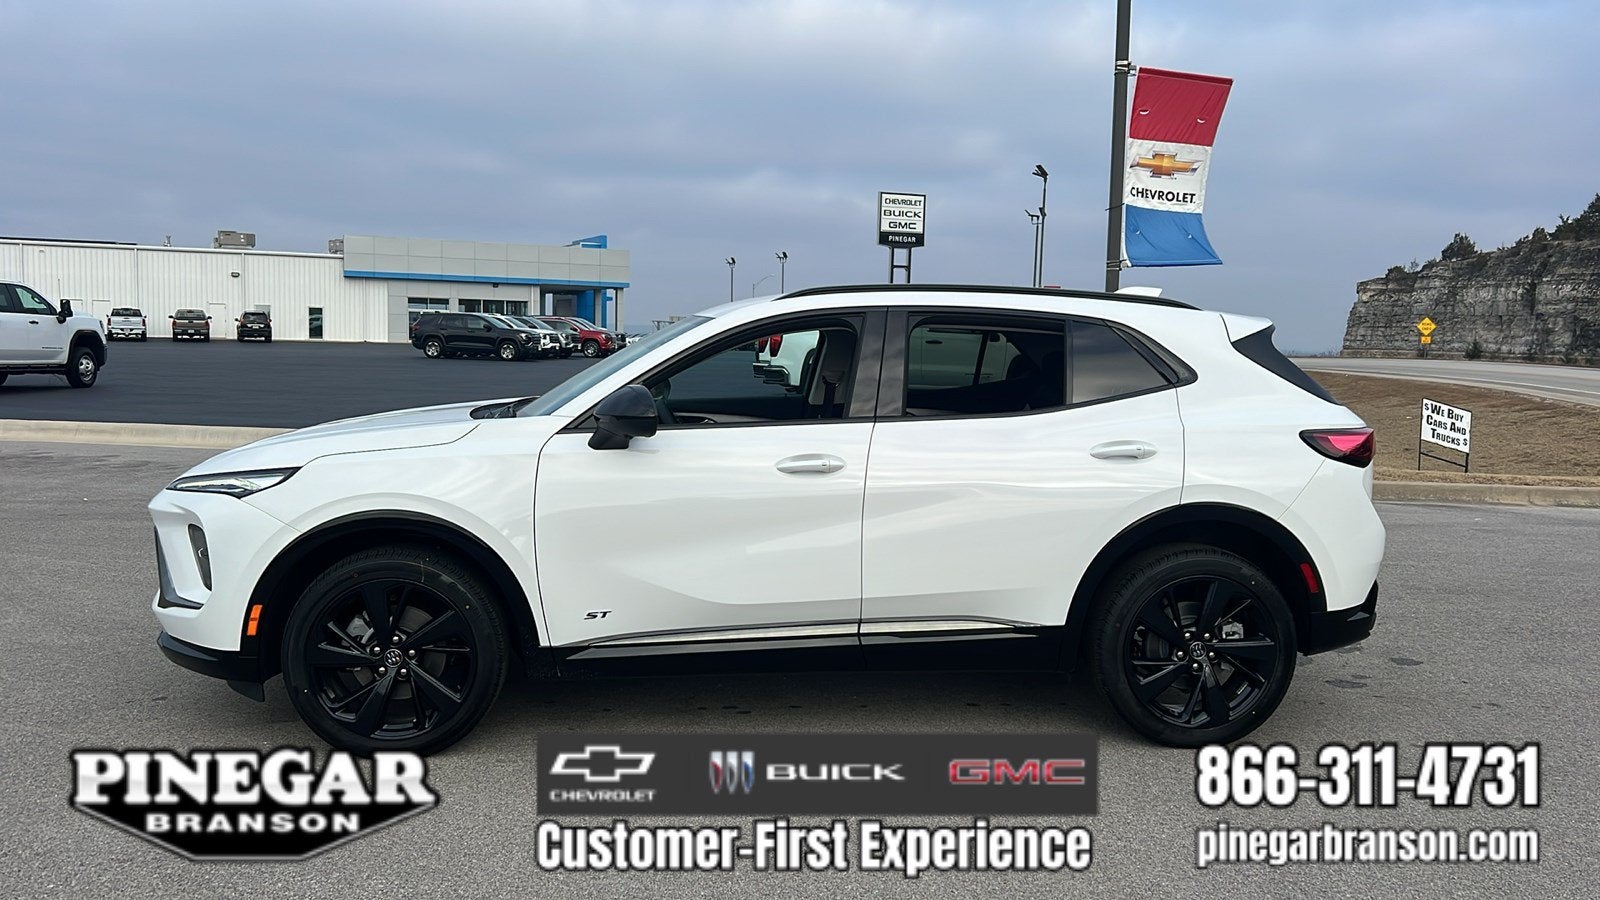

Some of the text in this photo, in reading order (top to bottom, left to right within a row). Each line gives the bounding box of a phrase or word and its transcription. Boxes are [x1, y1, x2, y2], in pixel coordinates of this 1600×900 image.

[1130, 187, 1196, 204] CHEVROLET
[884, 197, 922, 207] CHEVROLET
[883, 209, 922, 219] BUICK
[888, 221, 917, 230] GMC
[888, 235, 916, 243] PINEGAR
[583, 610, 613, 621] ST
